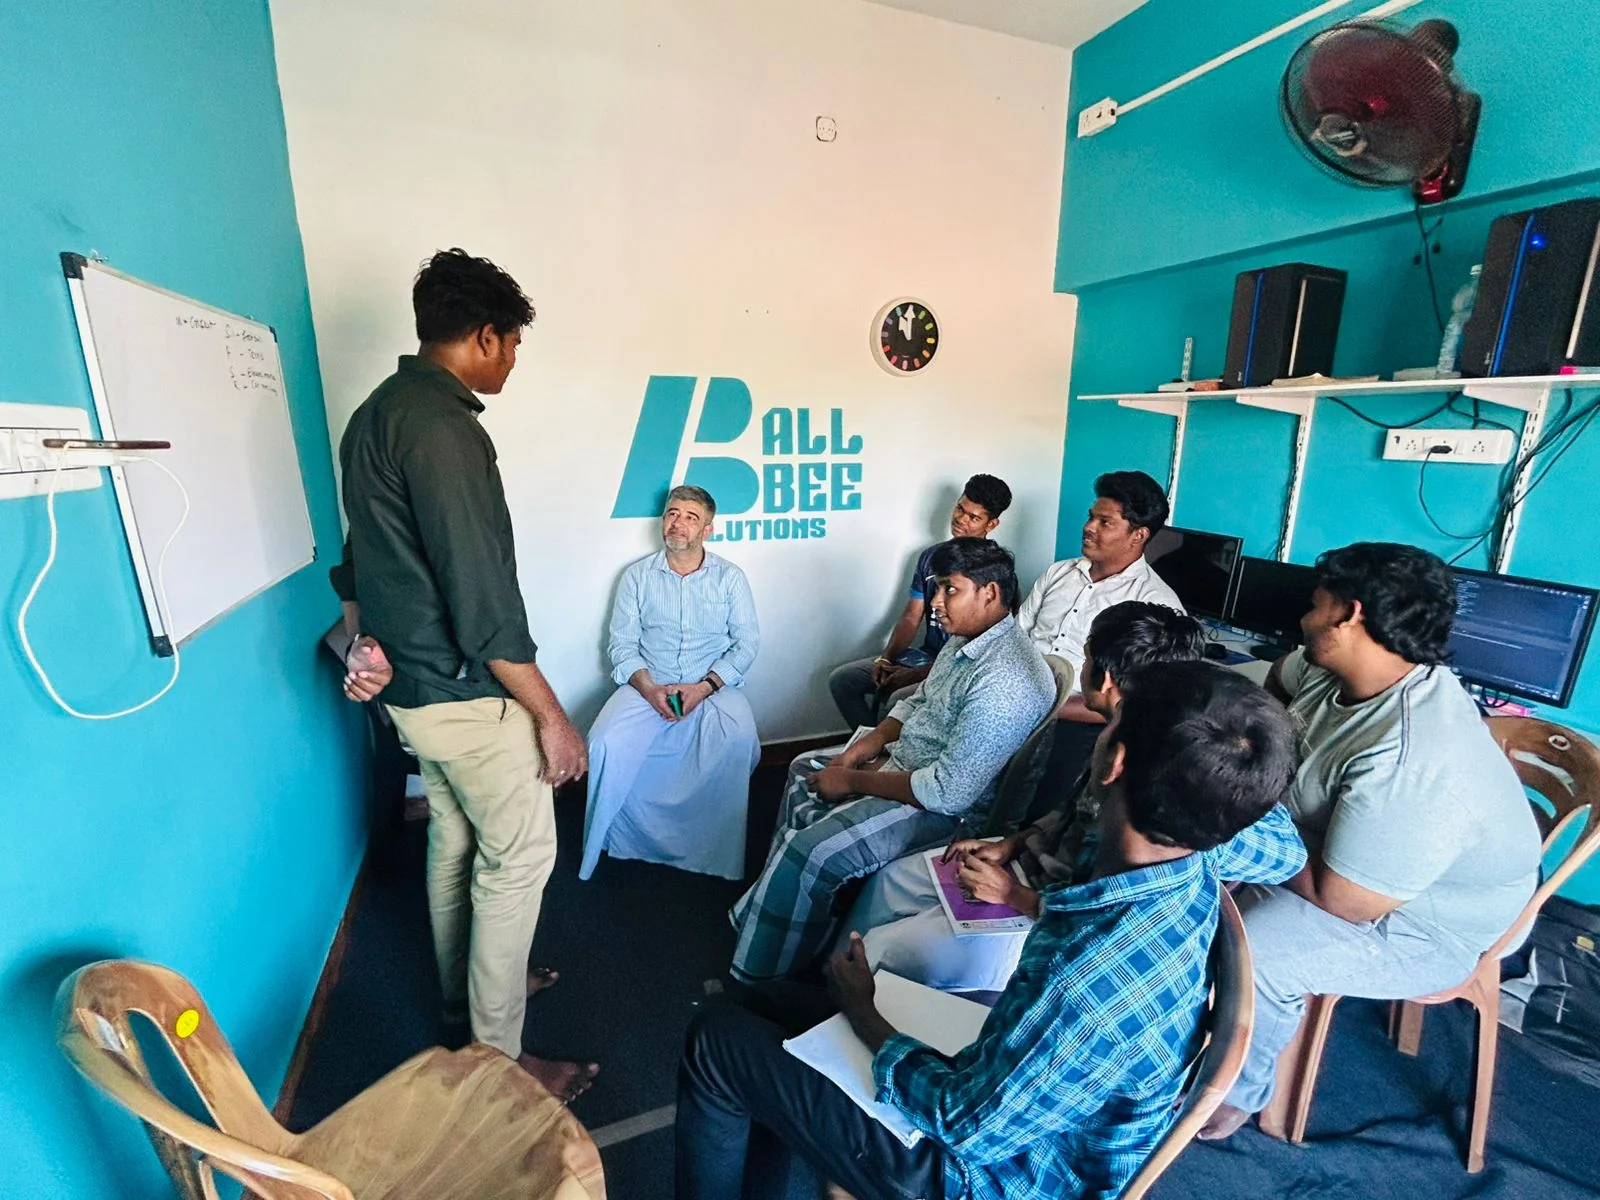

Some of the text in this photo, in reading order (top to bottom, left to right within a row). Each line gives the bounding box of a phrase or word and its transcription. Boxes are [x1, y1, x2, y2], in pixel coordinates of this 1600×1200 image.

[762, 407, 863, 456] ALL
[763, 462, 863, 514] BEE
[707, 517, 827, 543] LUTIONS
